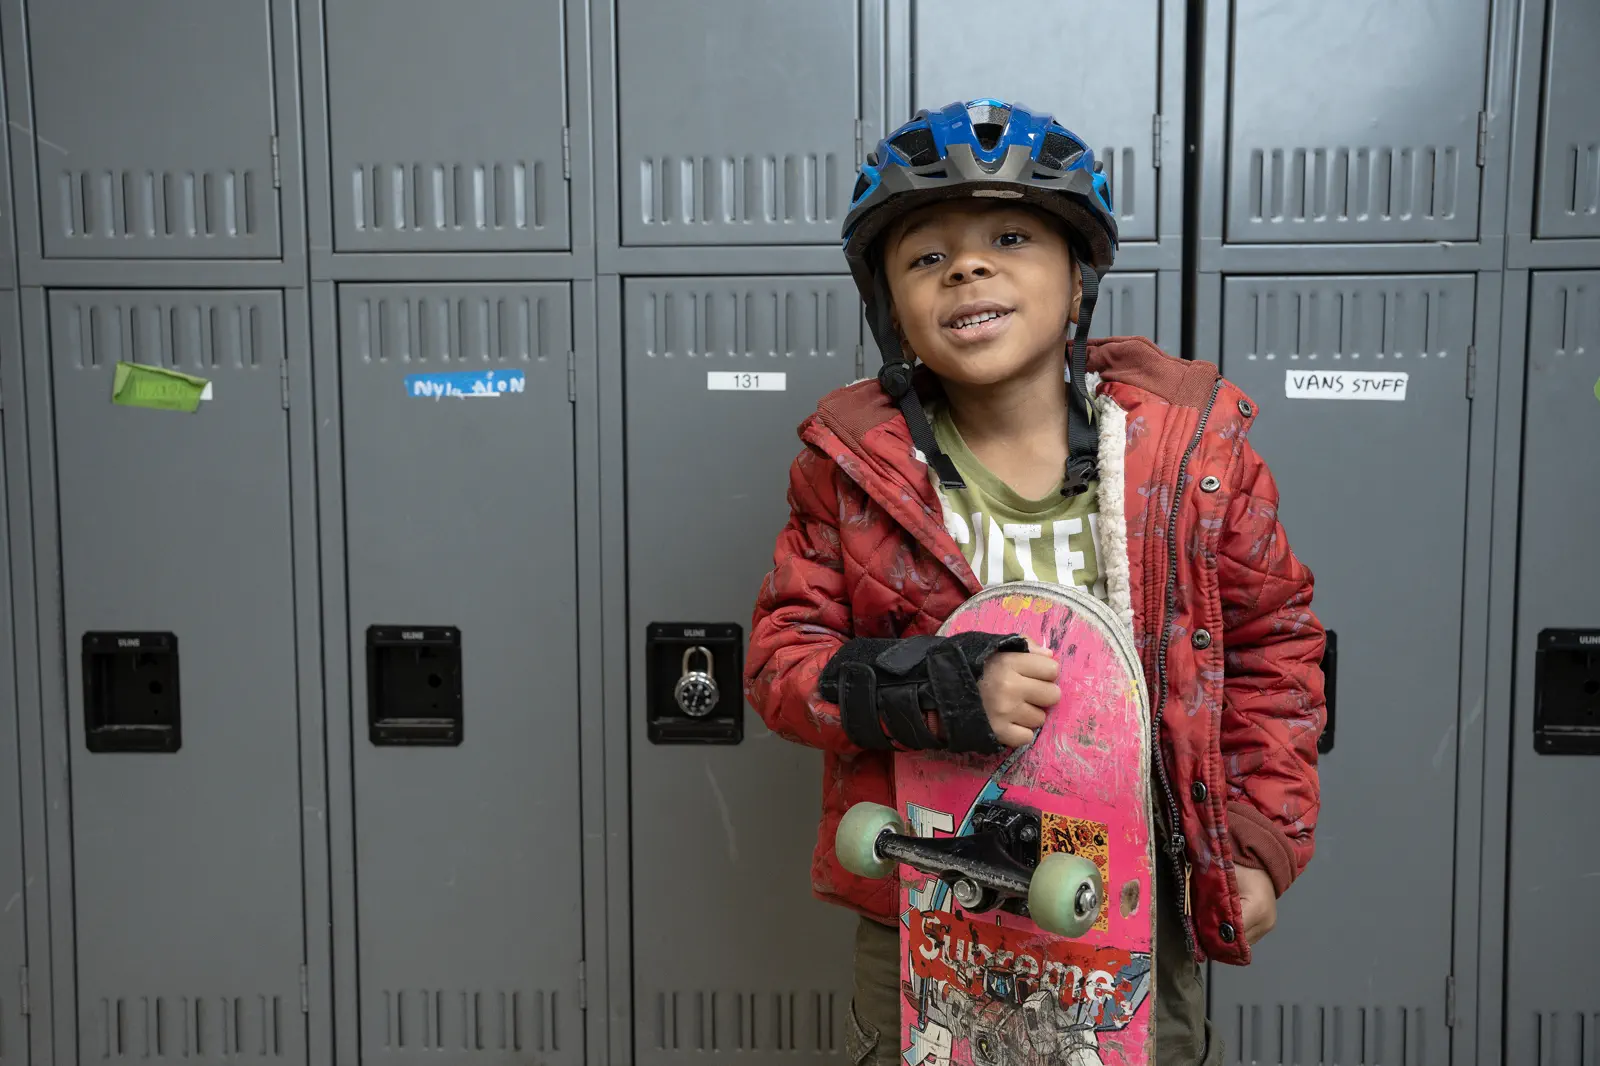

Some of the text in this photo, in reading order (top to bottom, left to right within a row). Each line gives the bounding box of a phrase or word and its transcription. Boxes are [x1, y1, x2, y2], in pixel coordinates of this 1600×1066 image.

[734, 374, 759, 388] 131
[1293, 374, 1405, 392] VANS STUFF
[918, 916, 1115, 1003] Supreme
